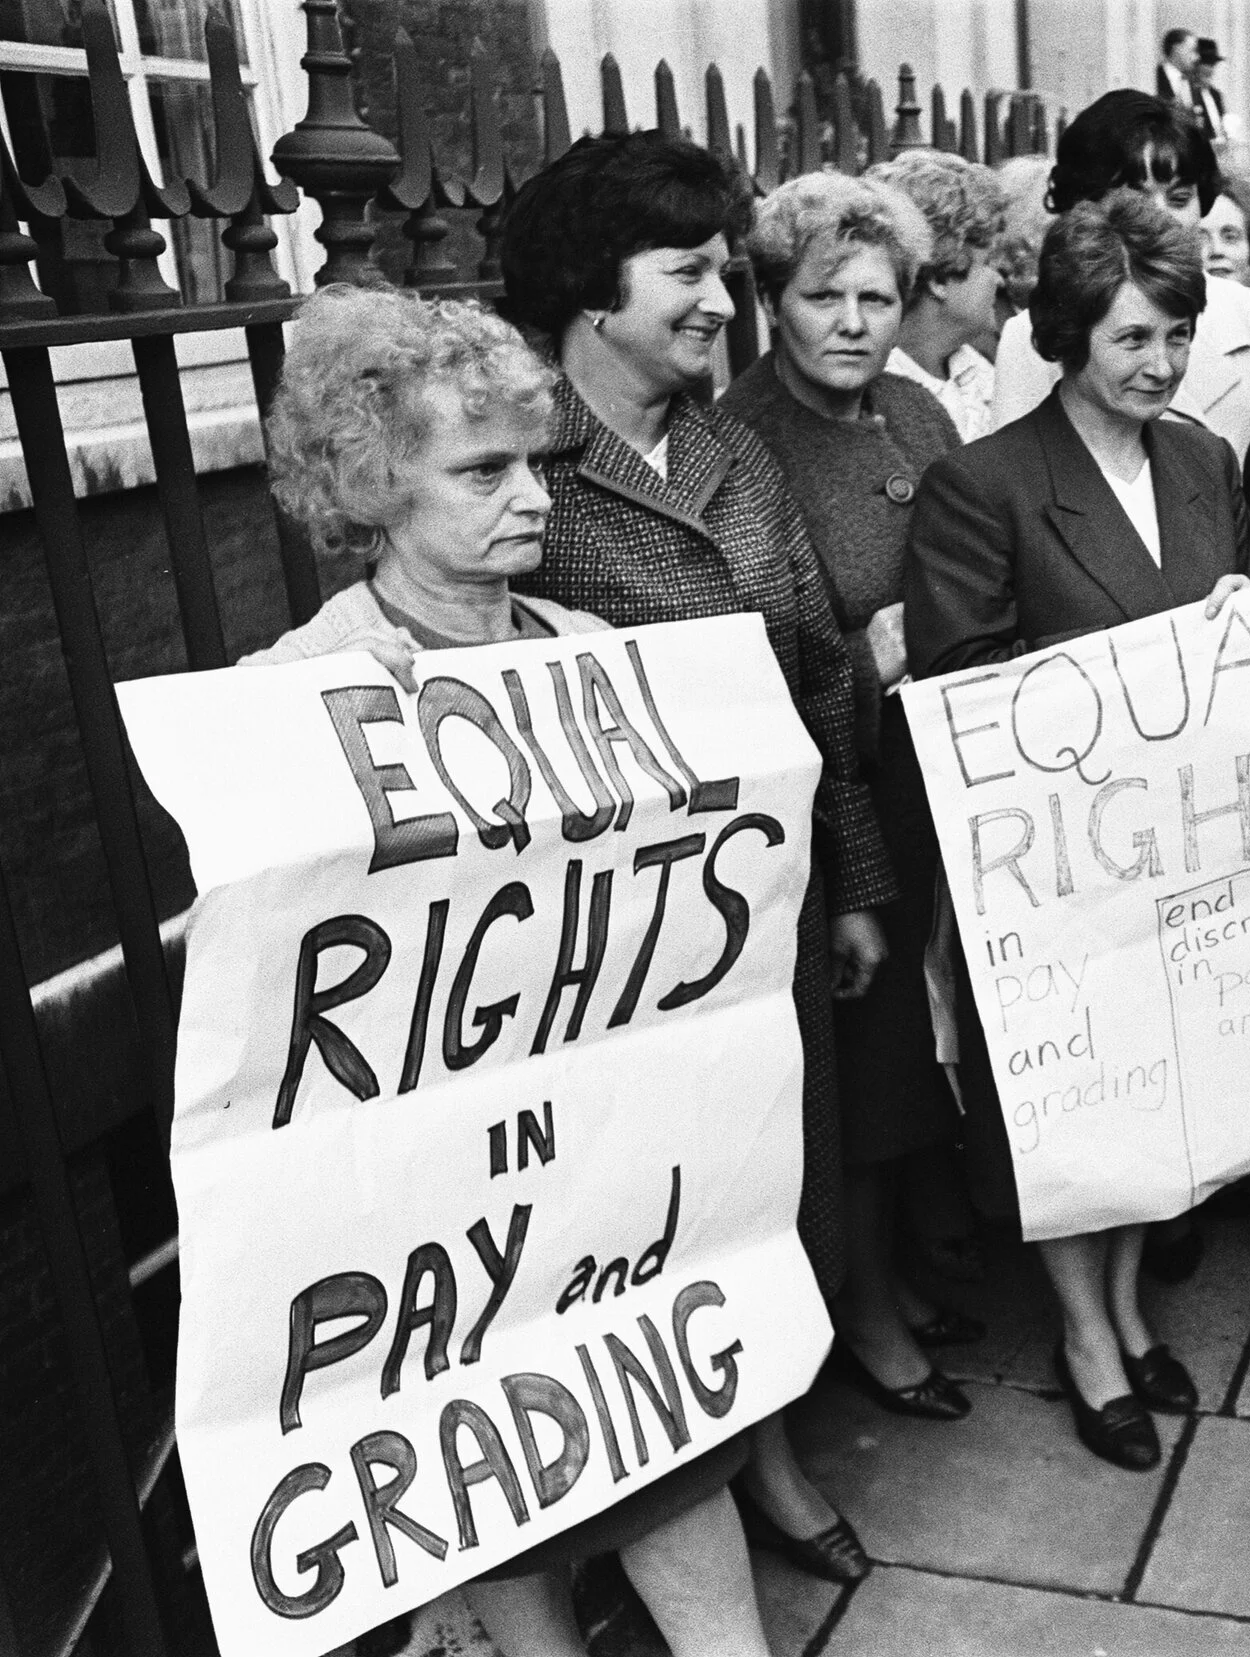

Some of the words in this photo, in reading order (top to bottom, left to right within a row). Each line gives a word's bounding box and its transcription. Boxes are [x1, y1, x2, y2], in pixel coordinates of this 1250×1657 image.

[321, 640, 740, 874] EQUAL
[1165, 880, 1234, 928] end
[272, 814, 786, 1129] RIGHTS
[985, 929, 1023, 967] in
[1177, 959, 1212, 986] in
[995, 952, 1088, 1033] pay
[1008, 1006, 1094, 1076] and
[487, 1101, 555, 1179] IN
[1013, 1058, 1166, 1155] grading
[280, 1204, 532, 1435] PAY
[556, 1164, 680, 1314] and
[250, 1280, 743, 1620] GRADING
